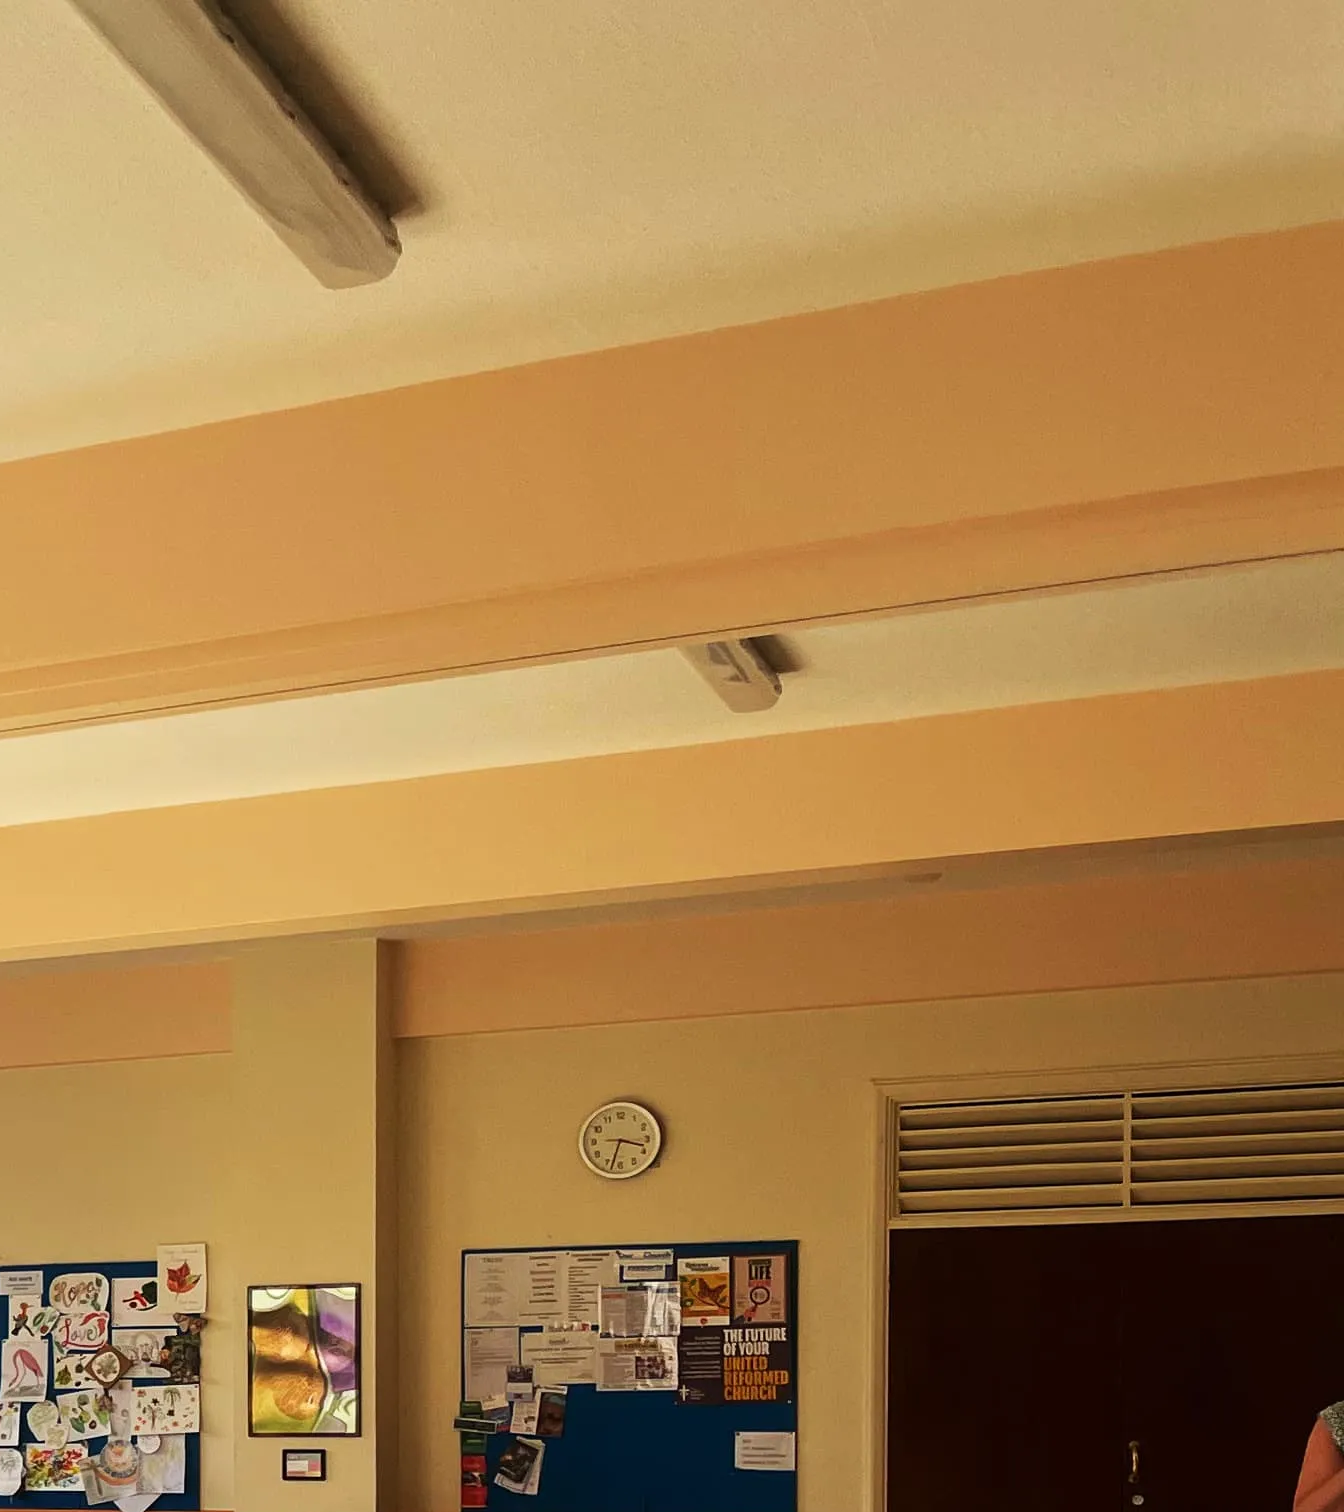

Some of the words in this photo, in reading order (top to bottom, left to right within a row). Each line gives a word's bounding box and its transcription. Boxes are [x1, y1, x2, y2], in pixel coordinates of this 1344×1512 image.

[616, 1111, 625, 1120] 12
[594, 1125, 602, 1133] 10
[723, 1329, 744, 1342] THE
[745, 1327, 787, 1341] FUTURE
[723, 1342, 737, 1356] OF
[738, 1341, 770, 1355] YOUR
[724, 1356, 768, 1370] UNITED
[724, 1370, 789, 1385] REFORMED
[724, 1385, 777, 1401] CHURCH
